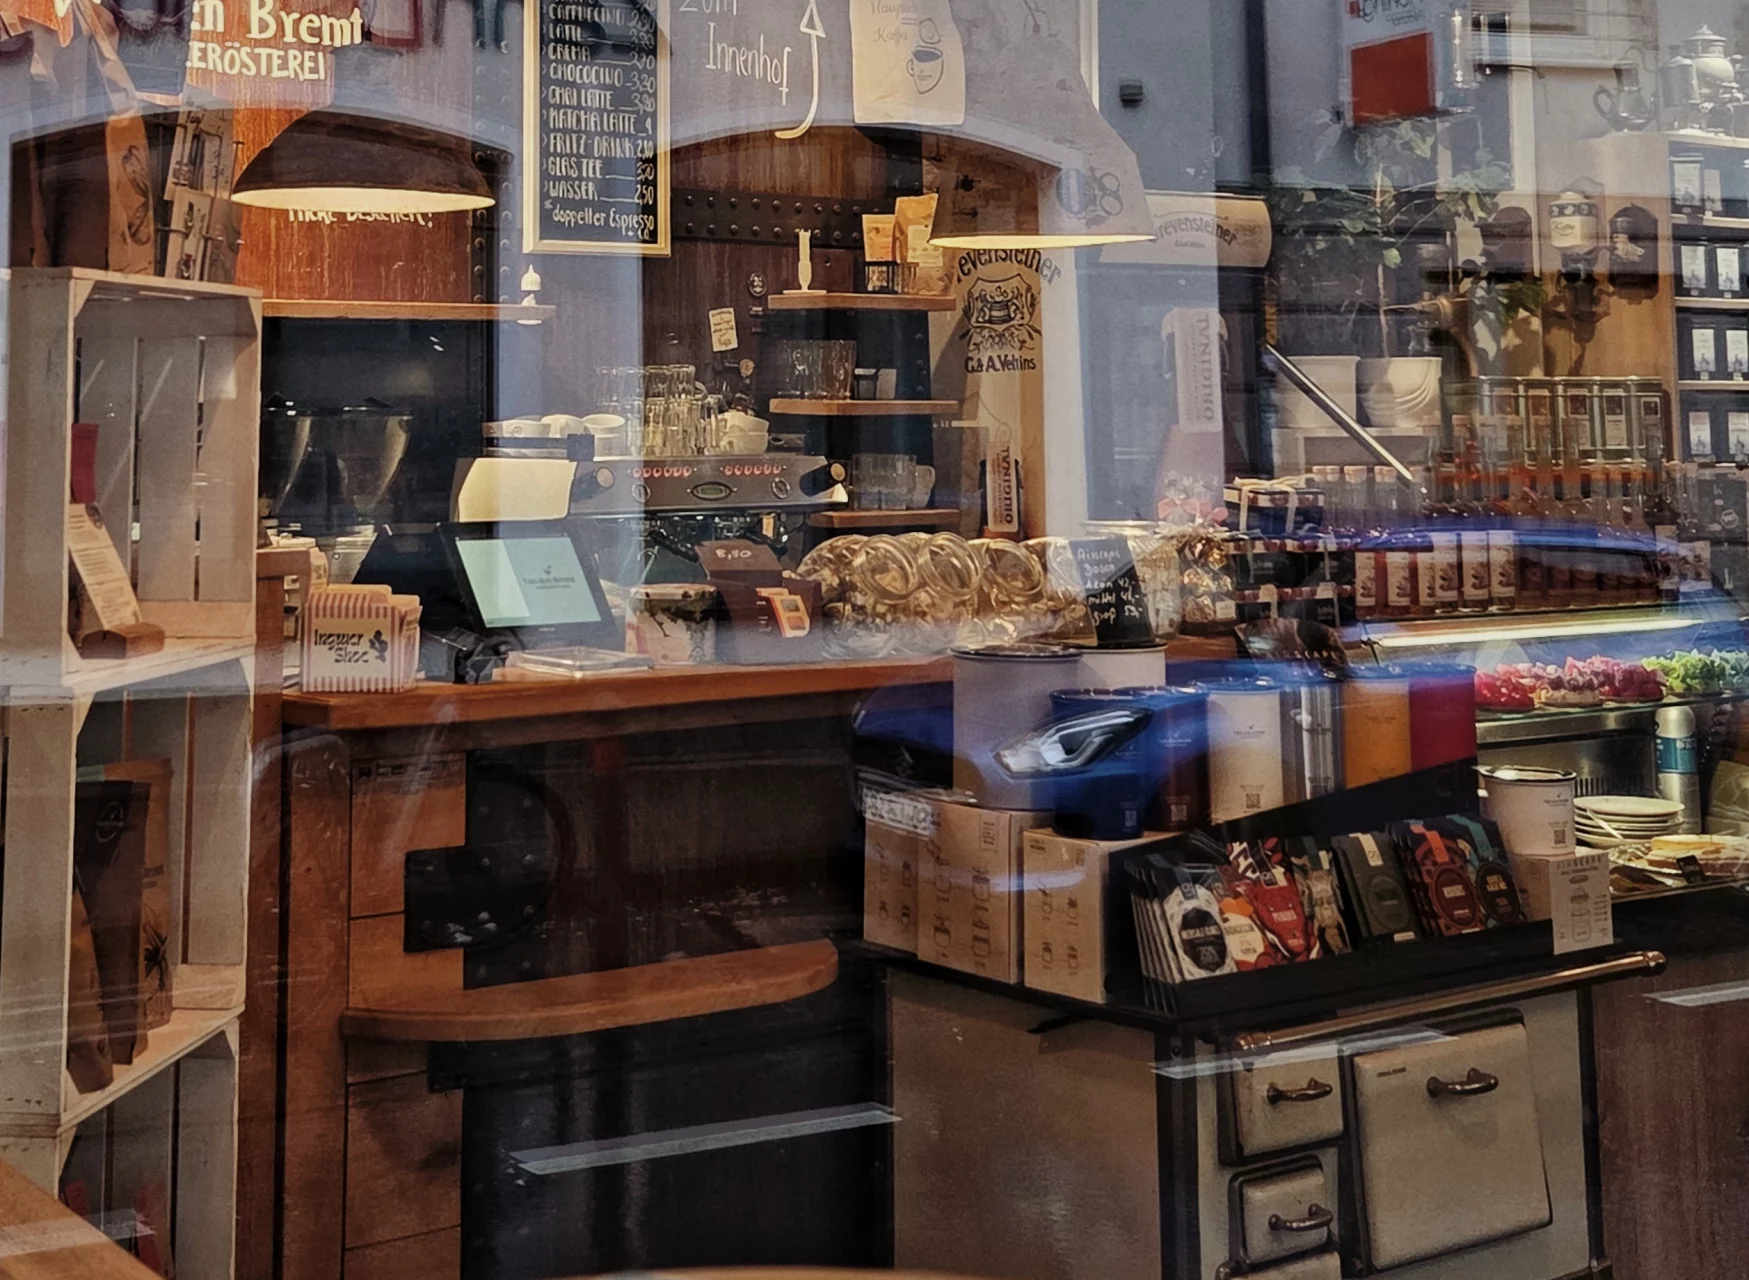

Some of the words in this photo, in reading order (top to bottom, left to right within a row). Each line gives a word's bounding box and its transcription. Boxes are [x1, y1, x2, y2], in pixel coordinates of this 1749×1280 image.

[549, 23, 583, 41] LATTE
[186, 40, 326, 82] ERÖSTEREI
[548, 42, 591, 62] CREMA
[705, 21, 792, 107] Innenhof
[549, 180, 598, 202] WASSER
[957, 248, 1062, 285] evensteiner
